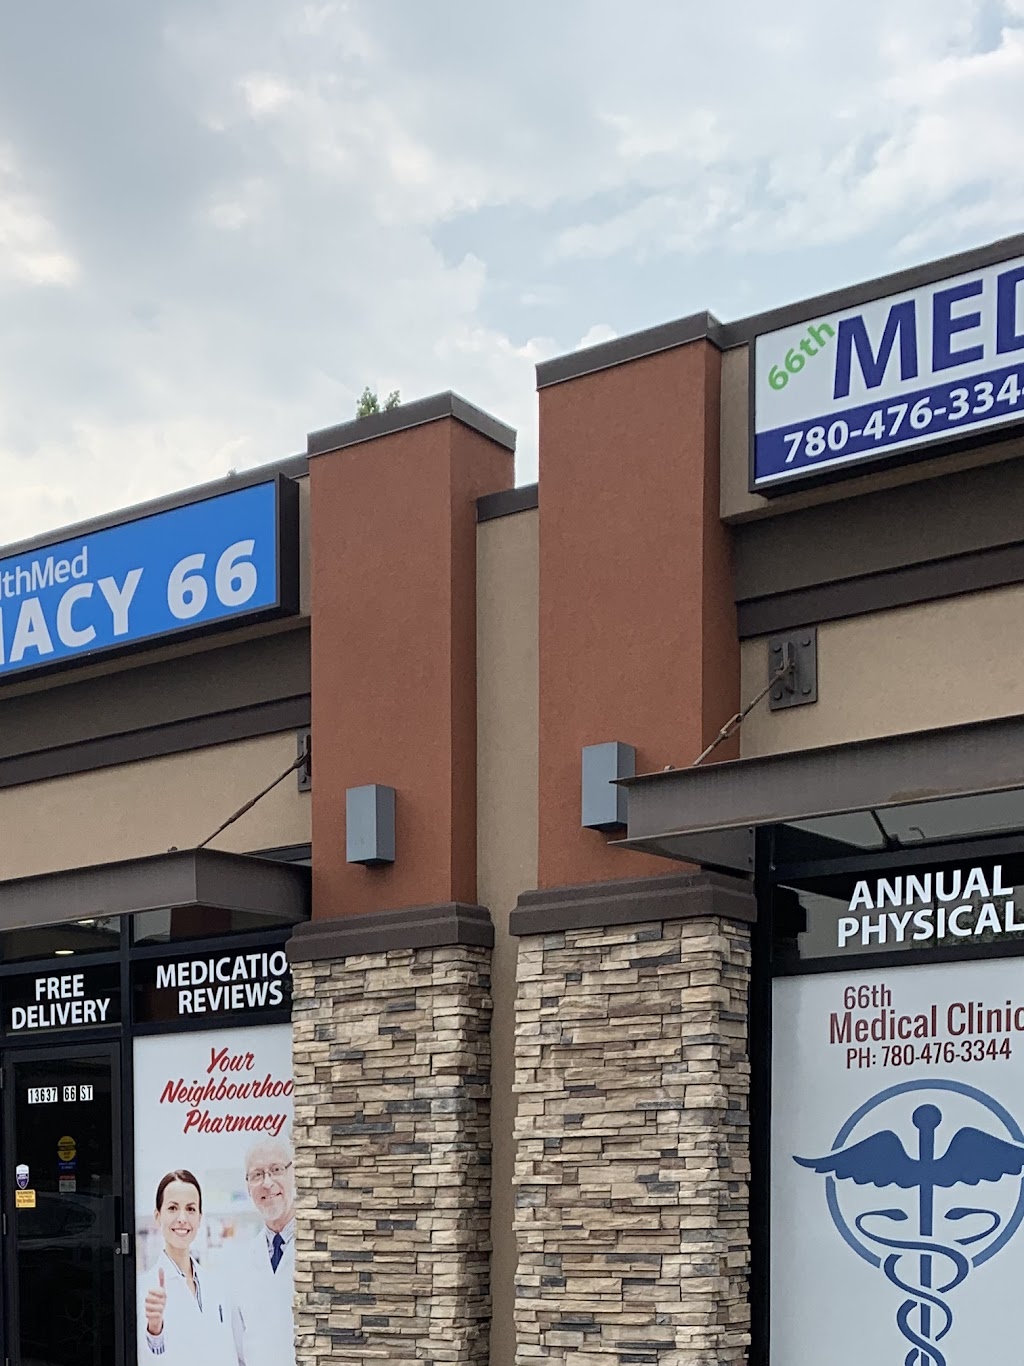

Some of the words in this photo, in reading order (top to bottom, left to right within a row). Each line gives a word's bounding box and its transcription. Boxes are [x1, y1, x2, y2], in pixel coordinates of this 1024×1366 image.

[768, 322, 836, 391] 66th
[783, 373, 1024, 464] 780-476-334
[166, 539, 259, 620] 66
[848, 865, 1014, 912] ANNUAL
[837, 901, 1024, 948] PHYSICAL
[156, 951, 293, 989] MEDICATIO
[35, 974, 85, 1001] FREE
[178, 980, 283, 1014] REVIEWS
[843, 984, 892, 1009] 66th
[11, 998, 111, 1030] DELIVERY
[829, 1005, 937, 1044] Medical
[206, 1047, 255, 1073] Your
[846, 1048, 877, 1069] PH:
[881, 1037, 1012, 1067] 780-476-3344
[29, 1087, 57, 1103] 13637
[64, 1086, 75, 1101] 66
[80, 1085, 92, 1100] ST
[159, 1074, 294, 1107] Neighbourhoo
[183, 1109, 287, 1137] Pharmacy
